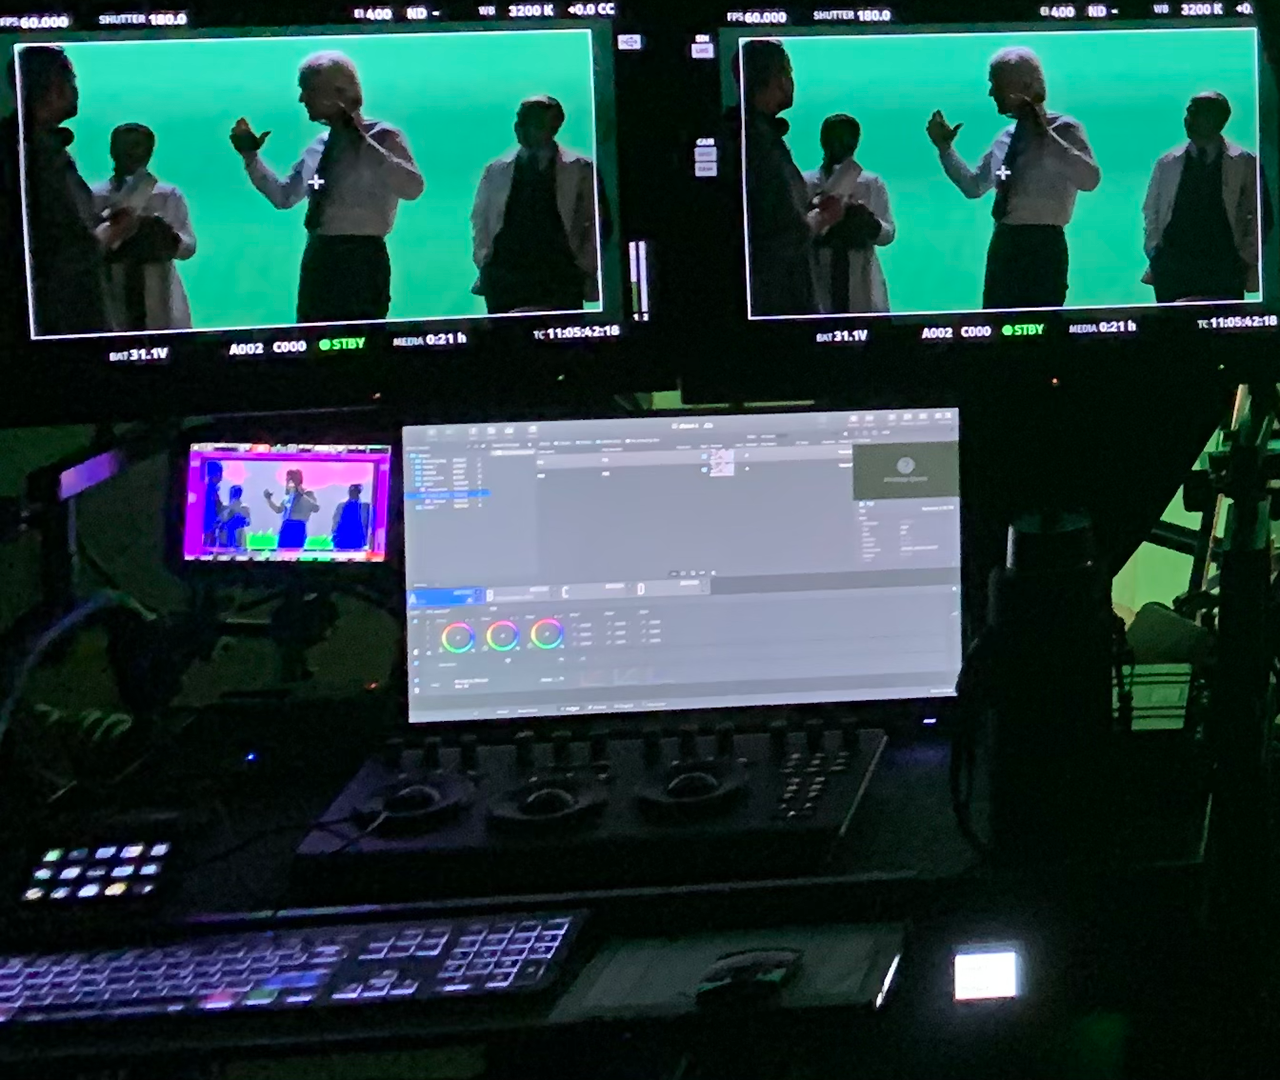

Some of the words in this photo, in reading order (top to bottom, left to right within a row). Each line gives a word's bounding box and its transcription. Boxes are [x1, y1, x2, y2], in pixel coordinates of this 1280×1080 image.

[366, 8, 393, 20] 400
[407, 7, 427, 19] ND
[508, 5, 541, 17] 3200
[543, 4, 553, 16] K
[597, 3, 615, 15] CC
[813, 10, 854, 21] SHUTTER
[857, 10, 891, 21] 180.0
[1051, 6, 1075, 18] 400
[1088, 5, 1107, 18] ND
[1181, 4, 1212, 16] 3200
[1213, 3, 1223, 15] K
[20, 16, 69, 29] 60.000
[99, 14, 146, 24] SHUTTER
[148, 13, 187, 25] 180.0
[727, 12, 743, 22] FPS
[744, 11, 787, 24] 60.000
[1069, 324, 1097, 334] MEDIA
[1099, 321, 1126, 333] 0:21
[1127, 320, 1136, 332] h
[1210, 315, 1277, 328] 11:05:42:18
[547, 324, 620, 339] 11:05:42:18
[833, 329, 868, 342] 31.1V
[922, 327, 953, 339] A002
[1014, 323, 1044, 336] STBY
[332, 337, 365, 350] STBY
[393, 336, 424, 346] MEDIA
[426, 333, 454, 346] 0:21
[457, 331, 467, 344] h
[129, 347, 169, 361] 31.1V
[229, 343, 264, 355] A002
